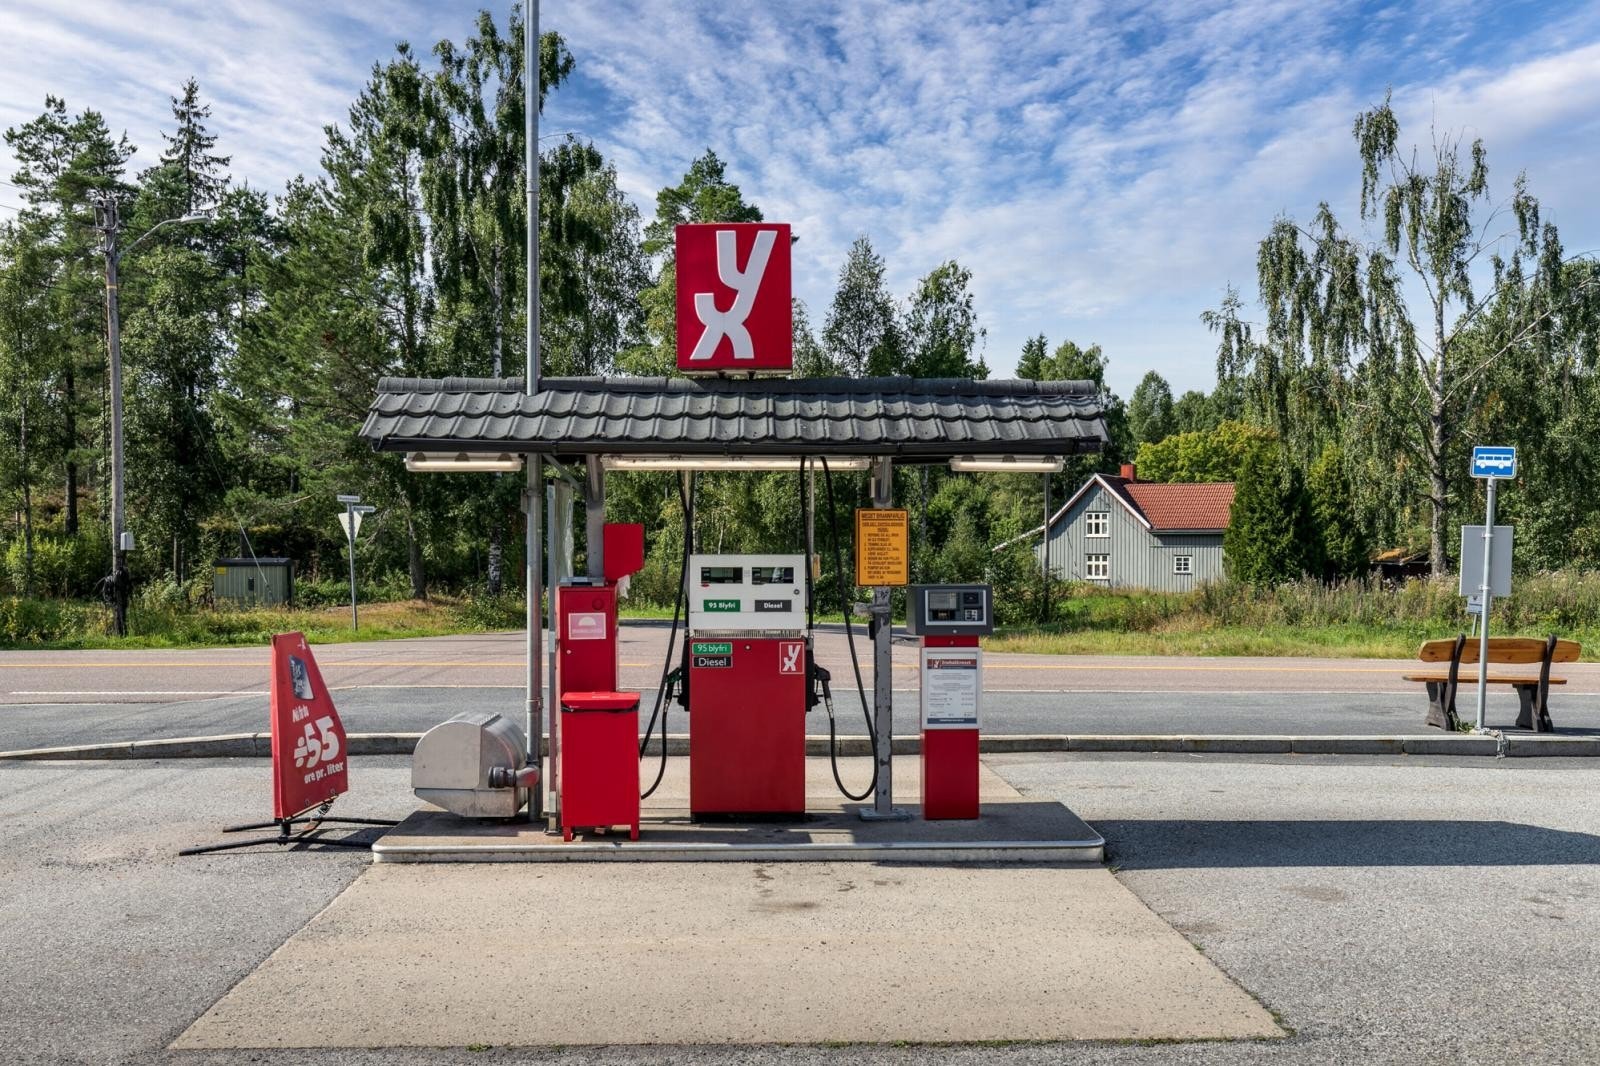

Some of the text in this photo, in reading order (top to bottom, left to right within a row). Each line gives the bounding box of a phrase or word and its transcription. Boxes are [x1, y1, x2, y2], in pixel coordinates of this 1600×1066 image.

[719, 602, 736, 610] Blyfri
[697, 644, 728, 654] 95 blyfri
[698, 657, 727, 667] Diesel
[327, 761, 344, 775] liter
